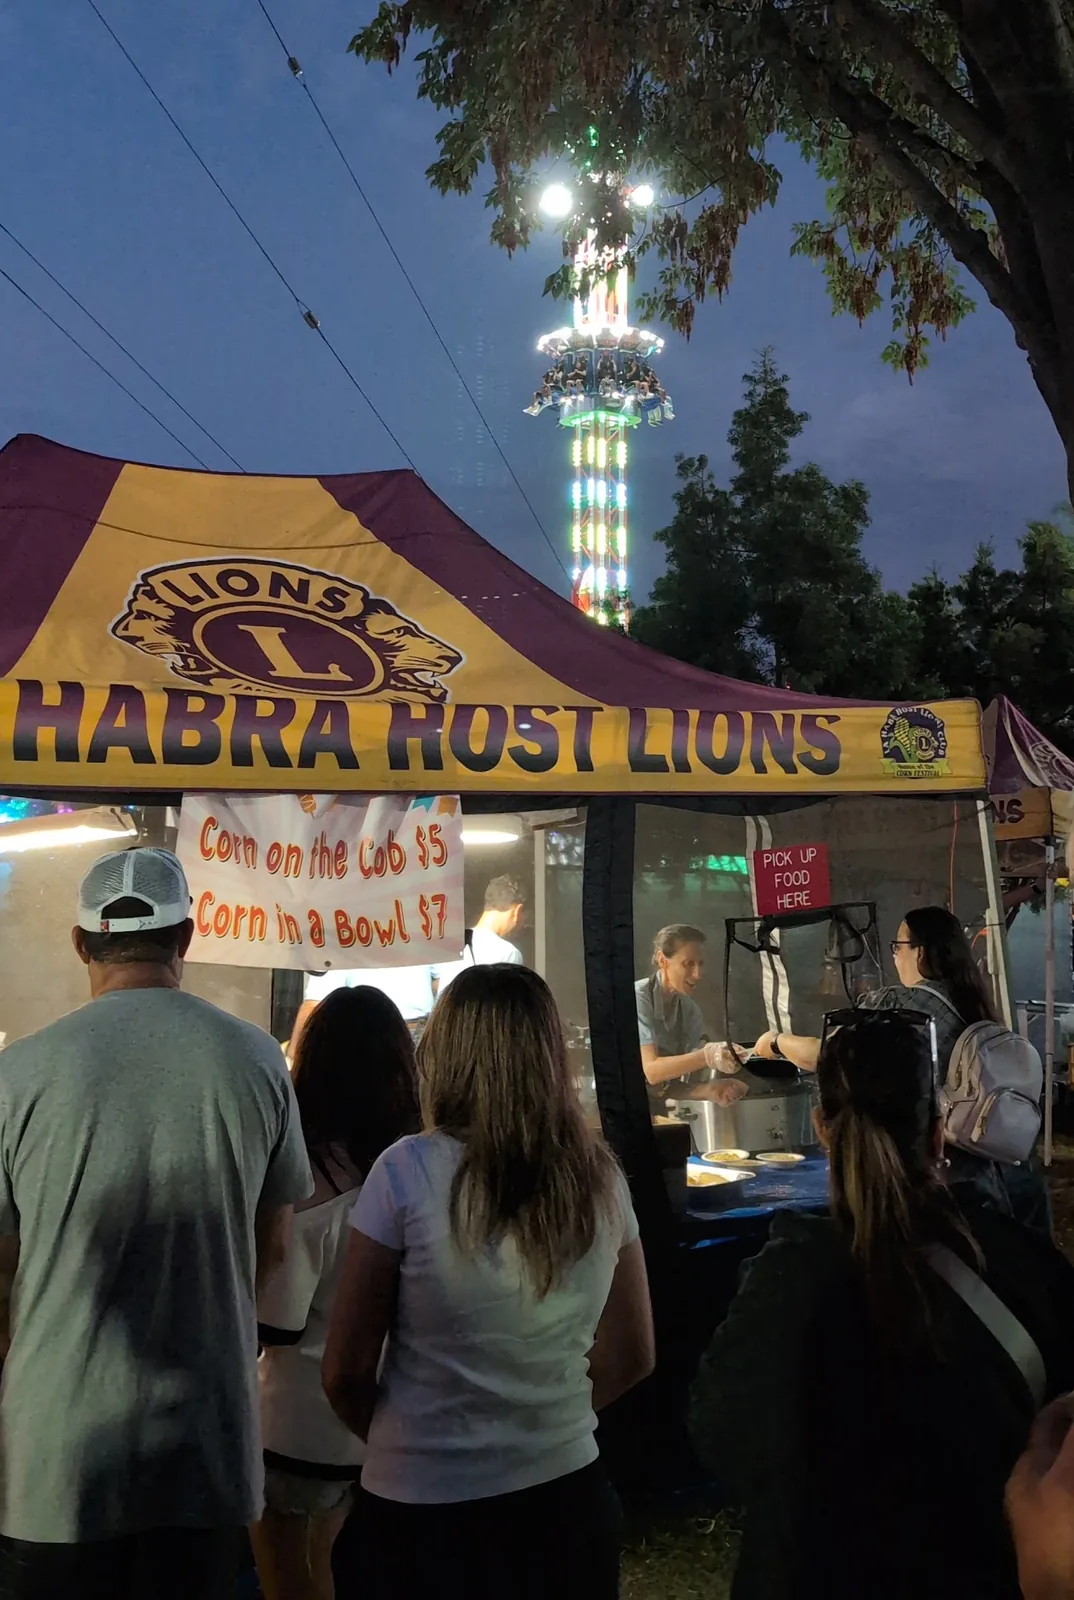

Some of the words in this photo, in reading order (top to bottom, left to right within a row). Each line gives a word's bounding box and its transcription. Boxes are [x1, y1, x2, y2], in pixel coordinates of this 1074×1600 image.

[162, 569, 351, 606] LIONS
[237, 624, 353, 681] L
[13, 679, 360, 769] HABRA
[388, 702, 604, 773] HOST
[628, 707, 841, 775] LIONS
[895, 707, 918, 716] HOST
[937, 731, 947, 756] CLUB
[200, 816, 258, 869] Corn
[266, 841, 303, 877] on
[309, 830, 348, 879] the
[359, 829, 406, 879] Cob
[415, 823, 448, 869] $5
[763, 851, 793, 868] PICK
[800, 848, 817, 863] UP
[774, 870, 810, 888] FOOD
[777, 891, 811, 909] HERE
[197, 891, 267, 941] Corn
[276, 903, 302, 944] in
[307, 909, 325, 947] a
[334, 899, 410, 947] Bowl
[419, 893, 447, 939] $7
